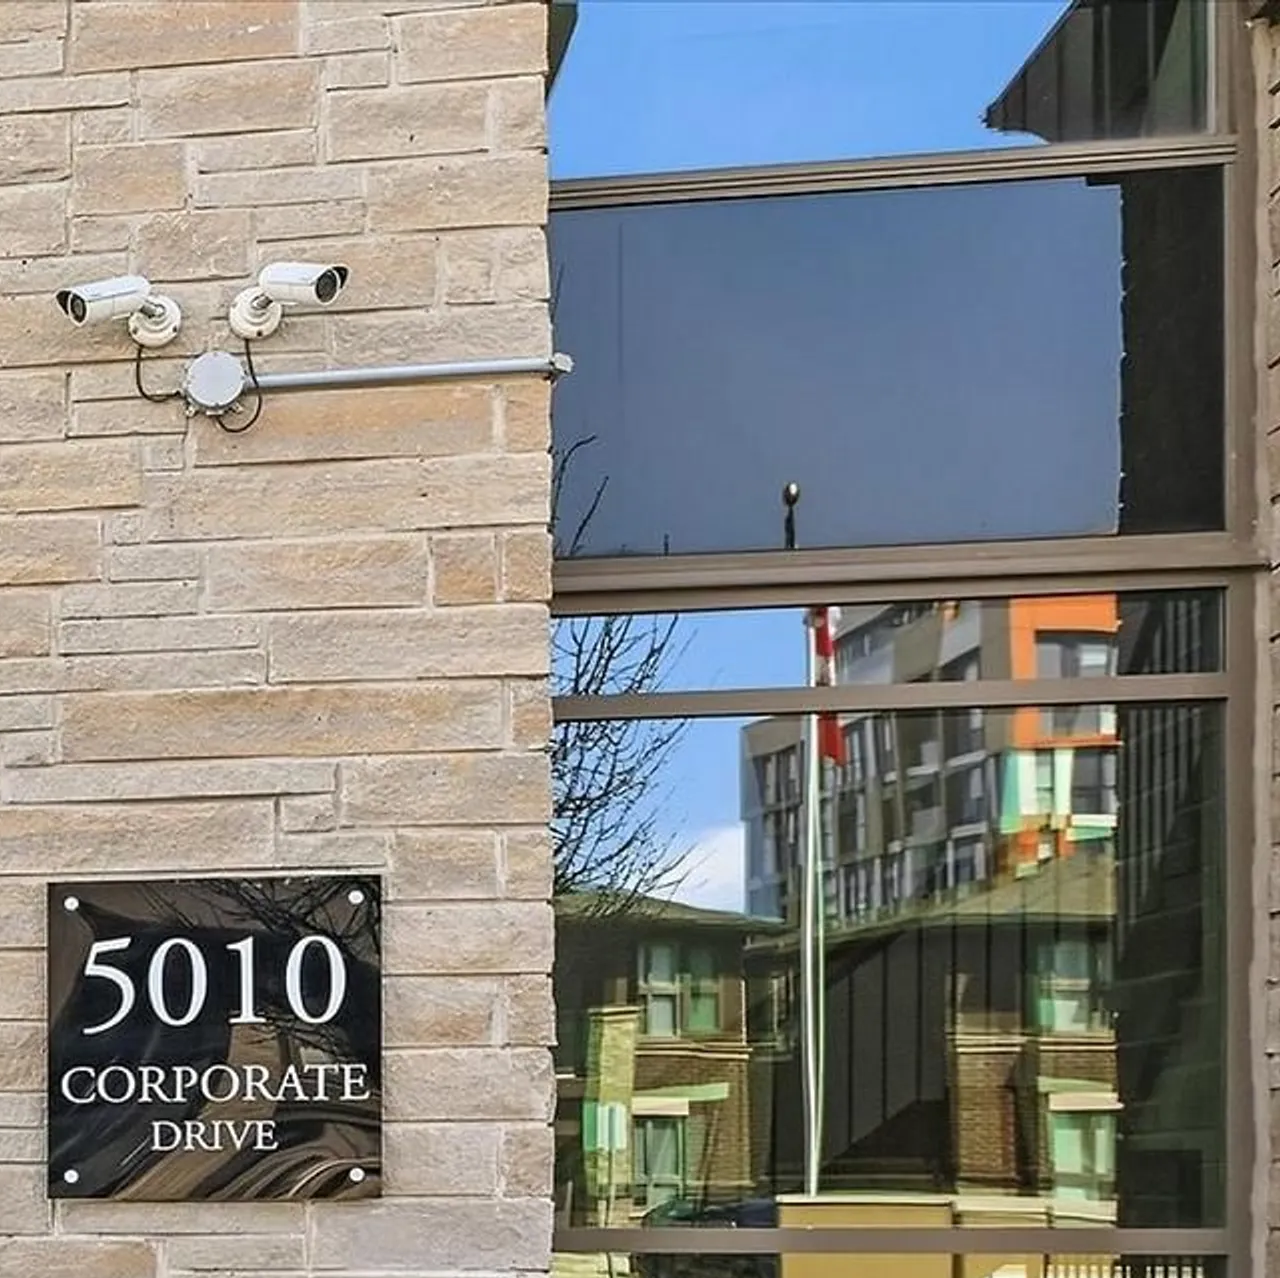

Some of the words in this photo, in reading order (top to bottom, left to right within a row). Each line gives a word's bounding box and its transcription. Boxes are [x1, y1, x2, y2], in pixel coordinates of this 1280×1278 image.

[82, 935, 346, 1035] 5010
[60, 1063, 371, 1105] CORPORATE
[151, 1120, 278, 1151] DRIVE
